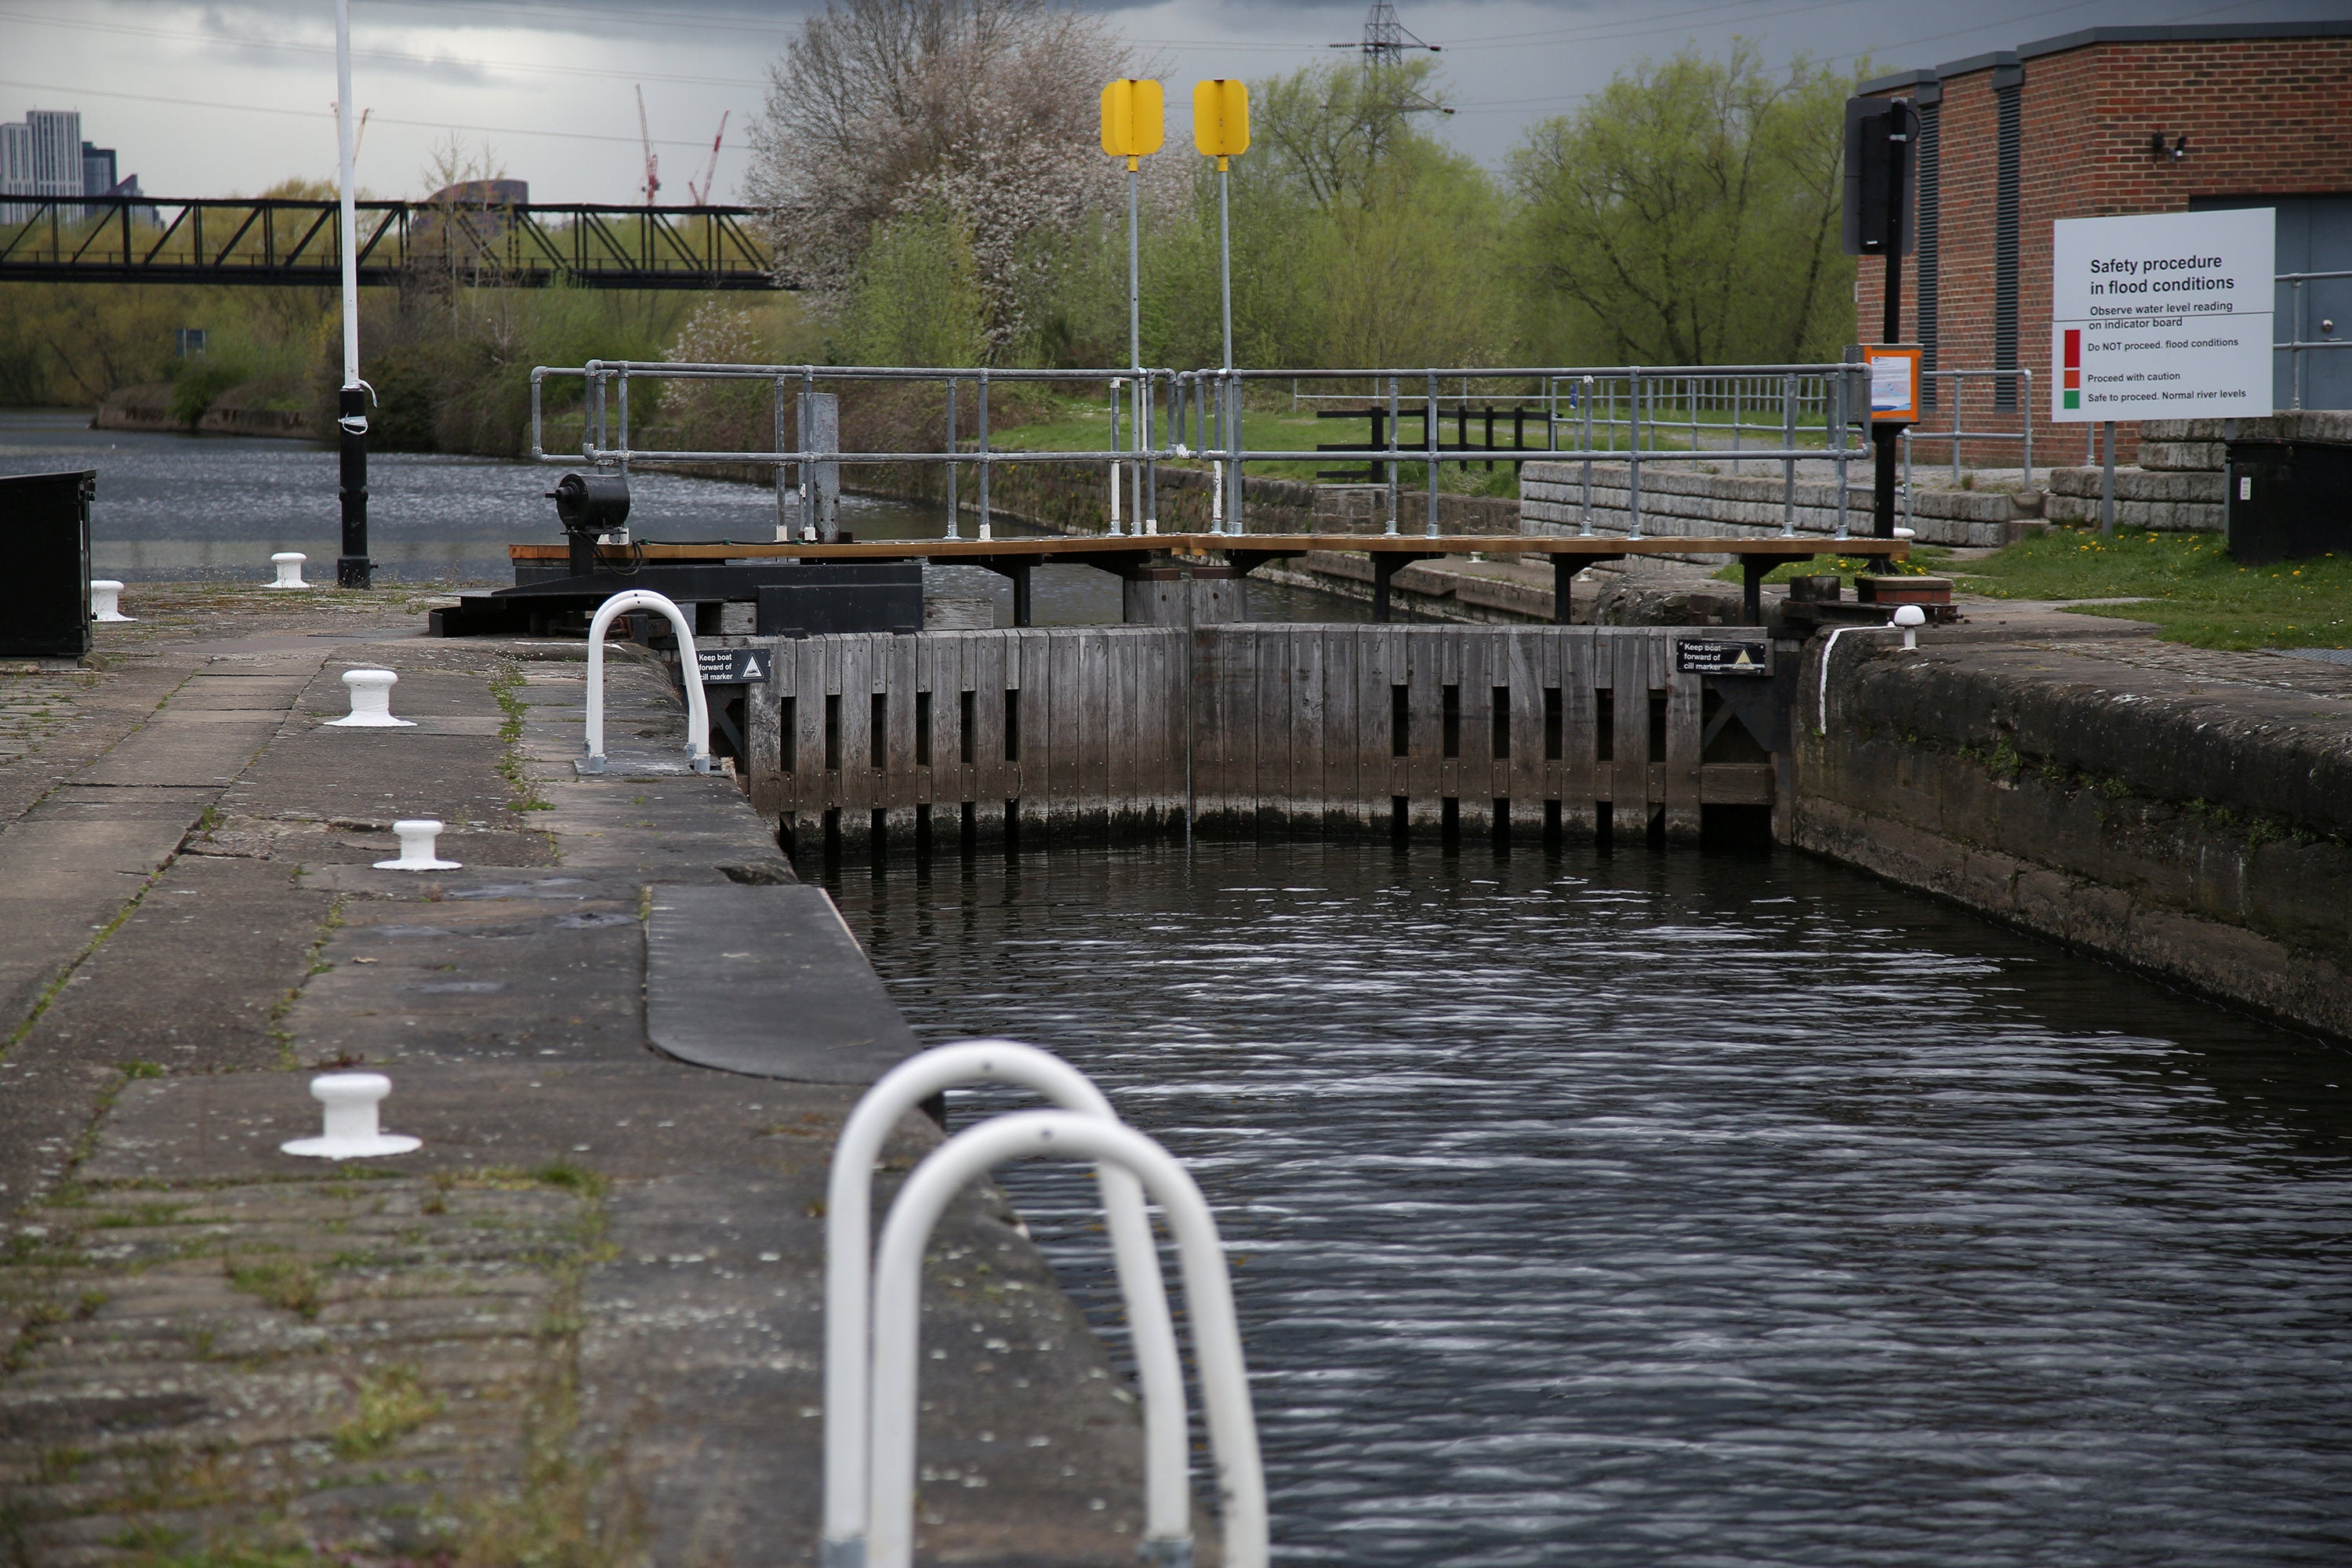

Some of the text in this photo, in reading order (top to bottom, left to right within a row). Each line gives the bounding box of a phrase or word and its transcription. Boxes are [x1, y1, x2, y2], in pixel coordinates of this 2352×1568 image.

[2091, 255, 2222, 275] Safety procedure
[2091, 276, 2234, 295] in flood conditions
[2090, 301, 2233, 316] Observe water level reading
[2105, 319, 2150, 329] indicator
[2153, 317, 2183, 328] board
[2088, 343, 2100, 351] Do
[2103, 342, 2122, 351] NOT
[2165, 339, 2189, 349] flood
[2191, 338, 2239, 348] conditions
[2088, 372, 2180, 383] Proceed with caution
[2088, 389, 2247, 403] Safe to proceed. Normal river levels
[1685, 643, 1703, 652] Keep
